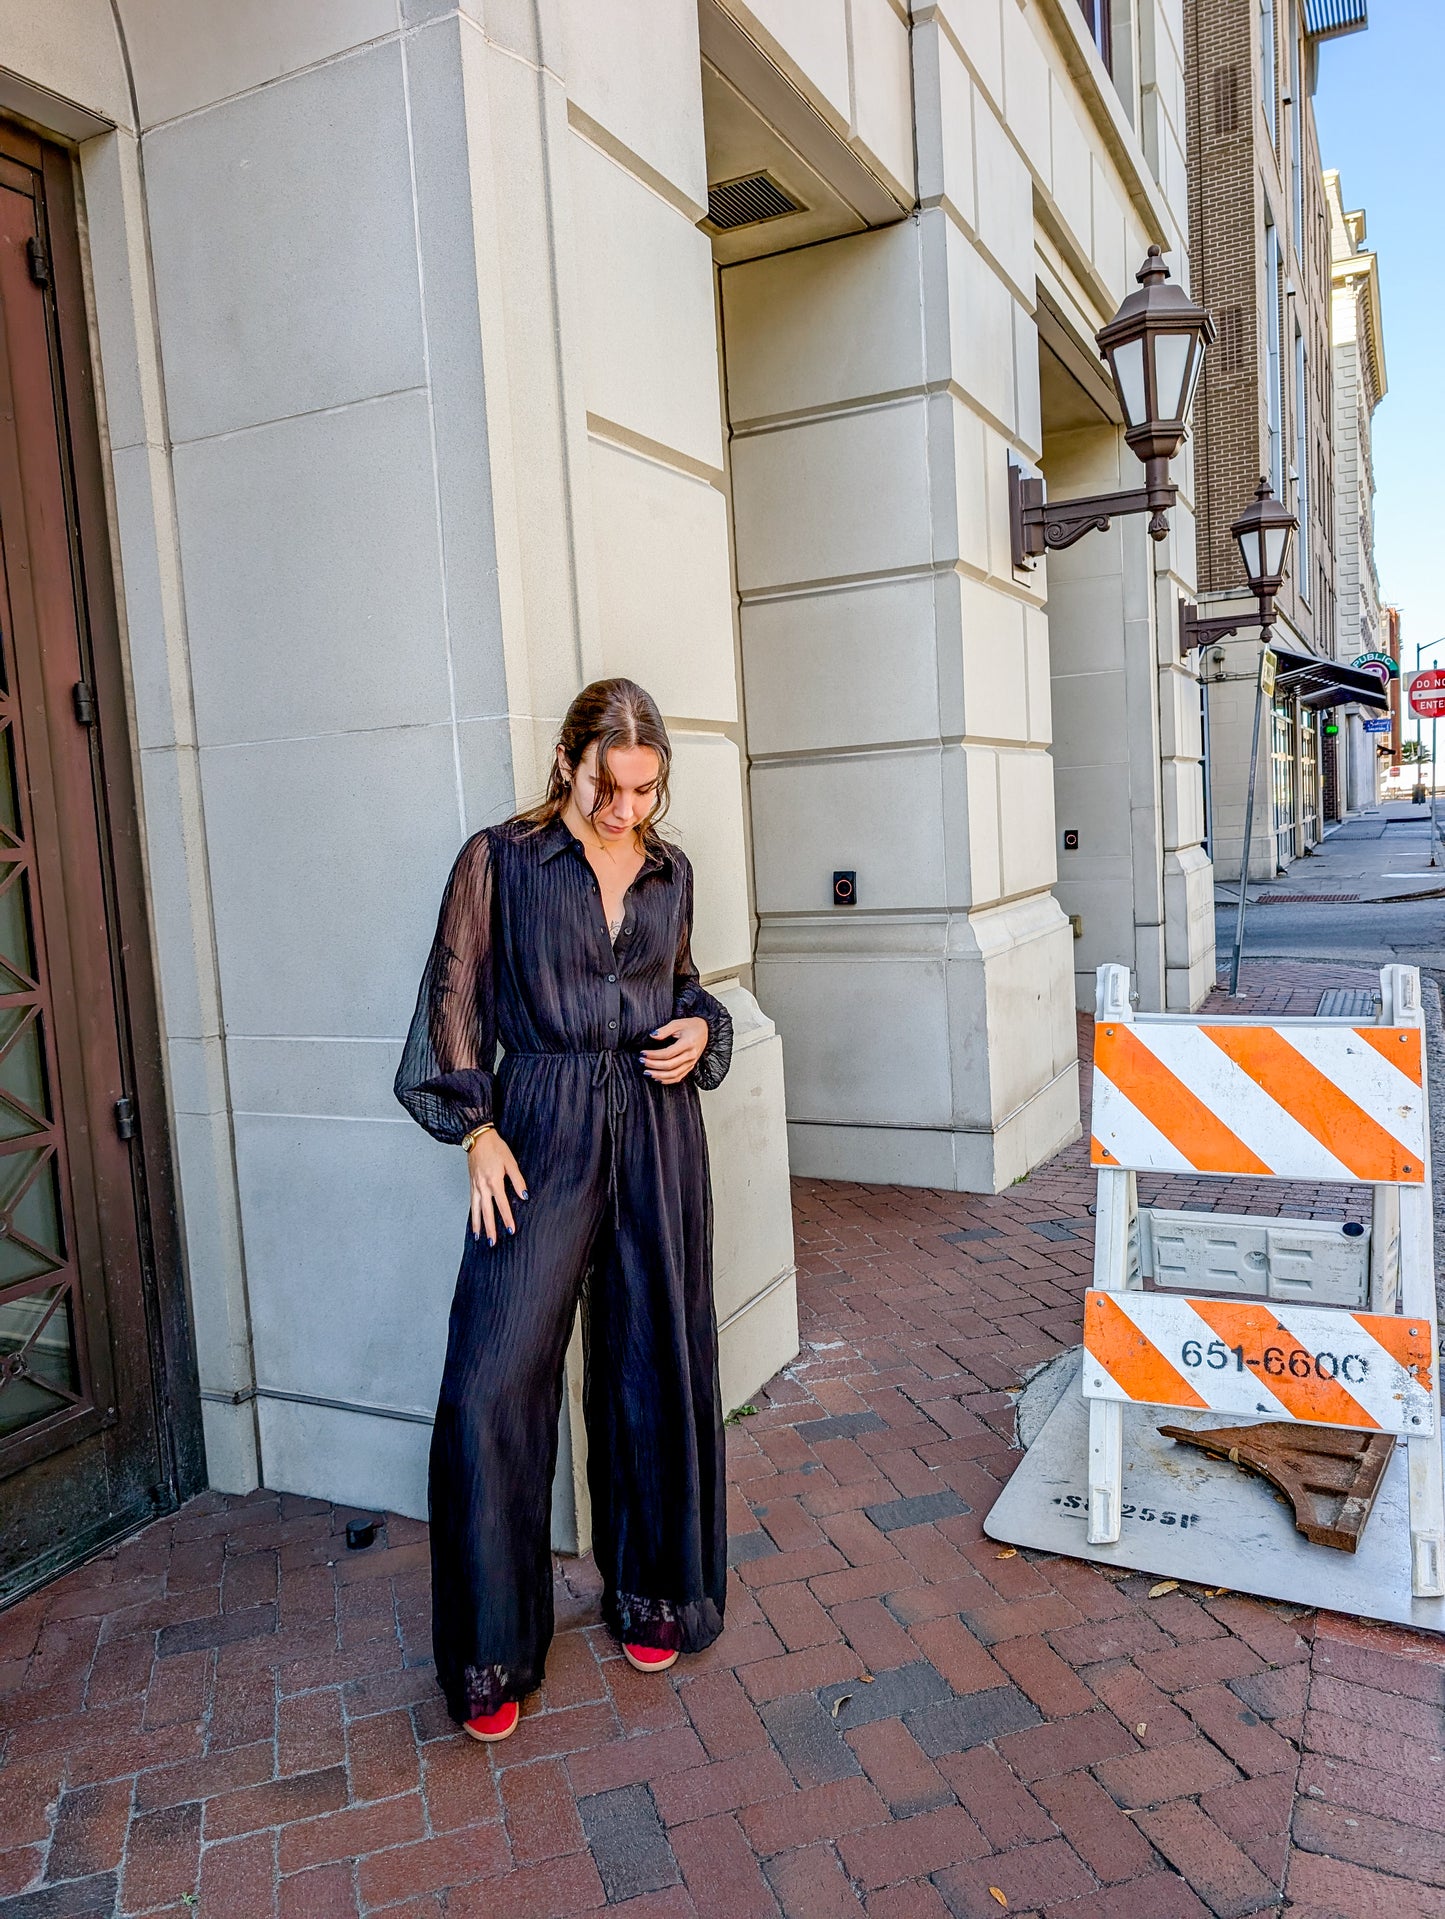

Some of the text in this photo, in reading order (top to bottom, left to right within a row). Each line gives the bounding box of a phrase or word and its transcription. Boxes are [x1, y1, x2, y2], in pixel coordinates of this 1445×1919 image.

[1352, 653, 1392, 668] PUBLIC
[1416, 680, 1430, 689] DO
[1181, 1340, 1370, 1384] 651-6600
